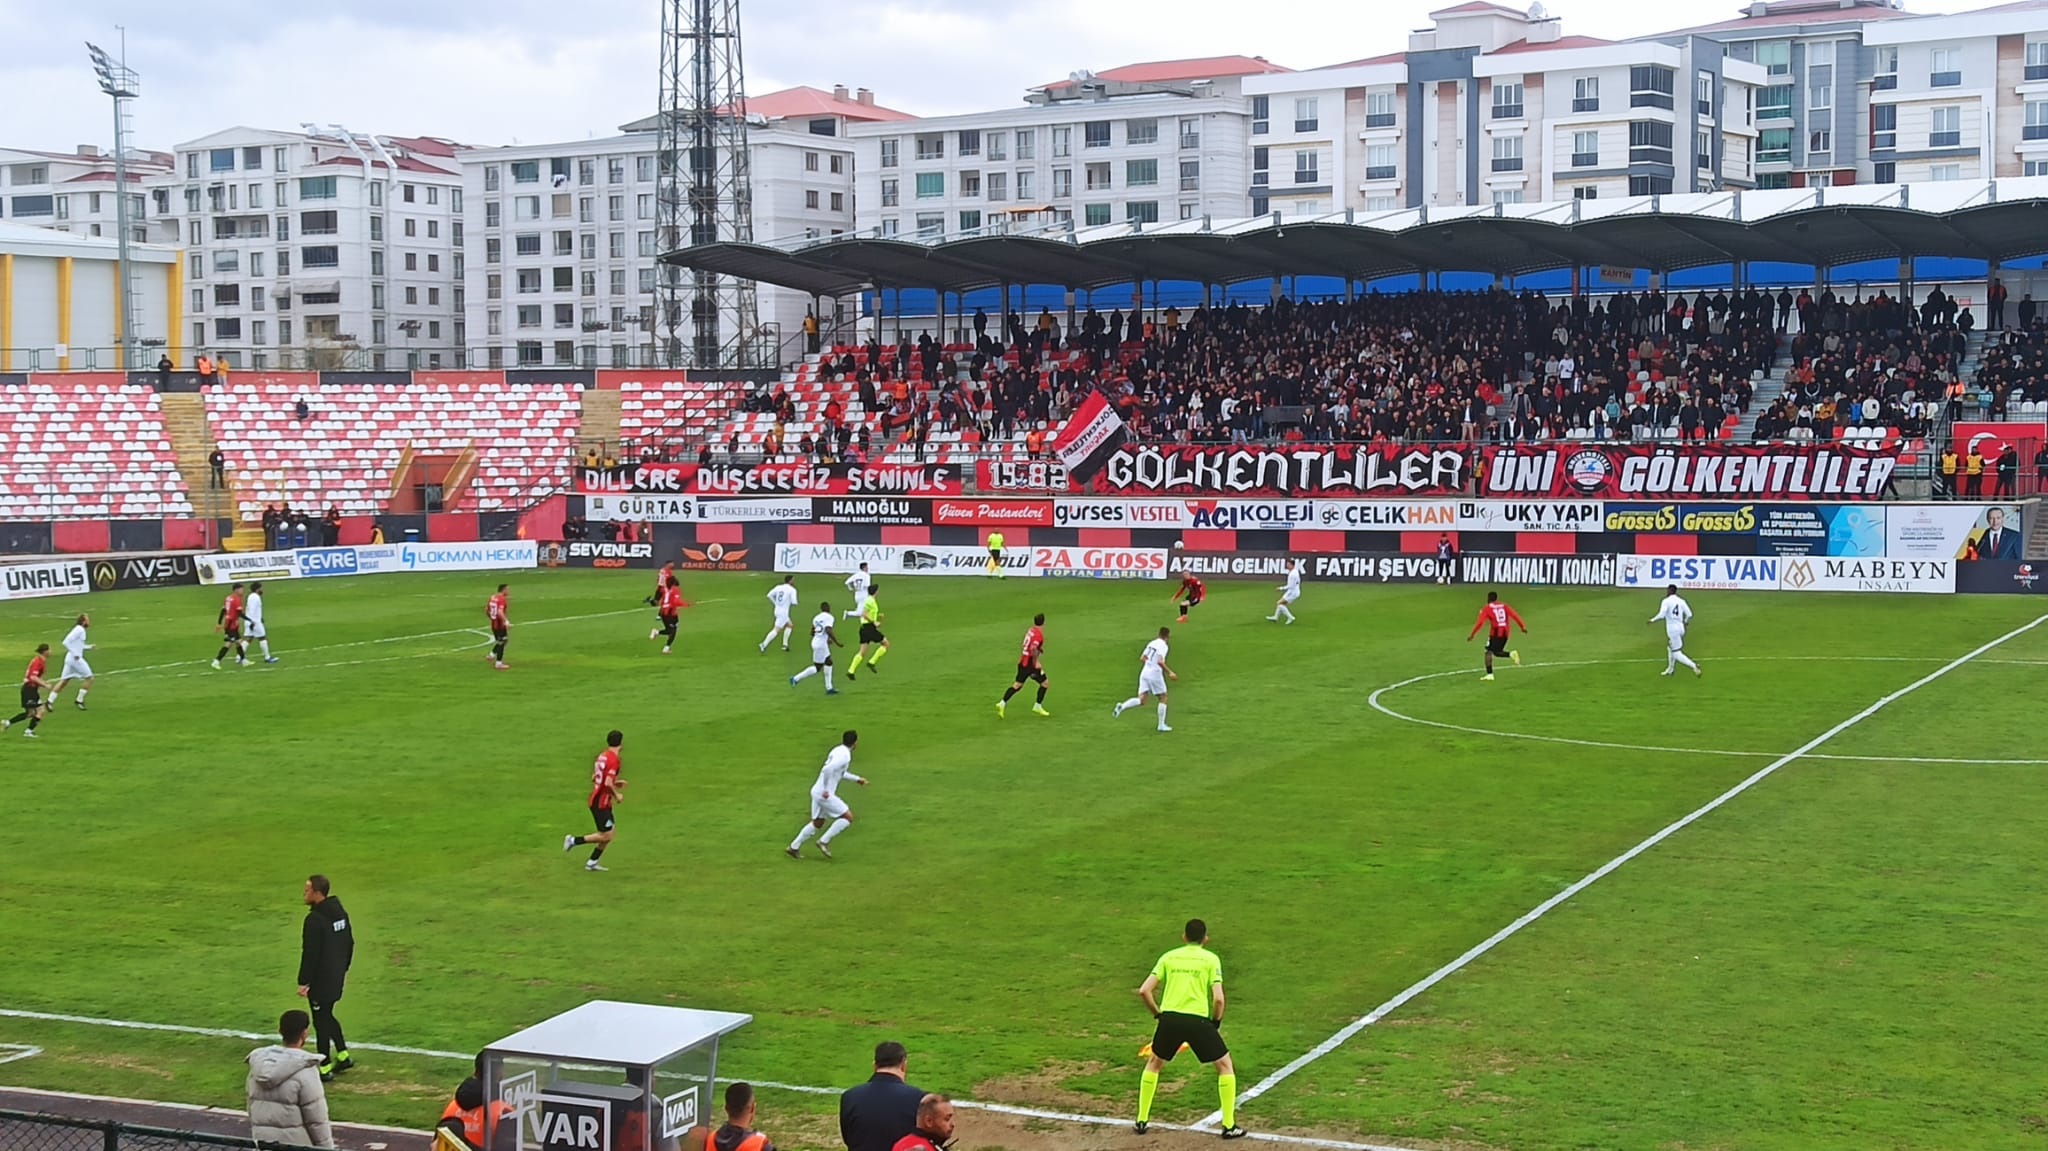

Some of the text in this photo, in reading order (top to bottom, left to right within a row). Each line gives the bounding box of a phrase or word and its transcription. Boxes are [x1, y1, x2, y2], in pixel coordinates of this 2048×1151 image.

[1107, 445, 1463, 491] GÖLKENTLİLER
[1489, 450, 1557, 491] ÜNİ
[1619, 450, 1896, 495] GÖLKENTLİLER
[585, 463, 949, 494] DİLLERE DÜŞECEĞİZ SENİNLE
[619, 495, 692, 519] GÜRTAŞ
[712, 505, 766, 516] TÜRKERLER
[832, 499, 910, 515] HANOĞLU
[938, 503, 1043, 521] Güven Pastaneleri
[1130, 505, 1181, 522] VESTEL
[1241, 500, 1313, 521] KOLEJİ
[1504, 504, 1599, 522] UKY YAPI
[418, 548, 533, 563] LOKMAN HEKİM
[569, 542, 652, 558] SEVENLER
[810, 546, 896, 561] MARYAP
[1035, 549, 1164, 569] 2A Gross
[122, 557, 189, 579] AVSU
[298, 552, 355, 573] ÇEVRE
[593, 558, 627, 567] GROUP
[1169, 556, 1229, 574] AZELİN
[1315, 557, 1375, 577] FATİH
[1462, 553, 1615, 585] VAN KAHVALTI KONAĞI
[1651, 558, 1776, 581] BEST VAN
[1824, 560, 1948, 579] MABEYN
[1047, 568, 1151, 578] TOPTAN MARKET
[1672, 604, 1679, 617] 4
[667, 1098, 694, 1125] VAR
[528, 1110, 600, 1150] VAR
